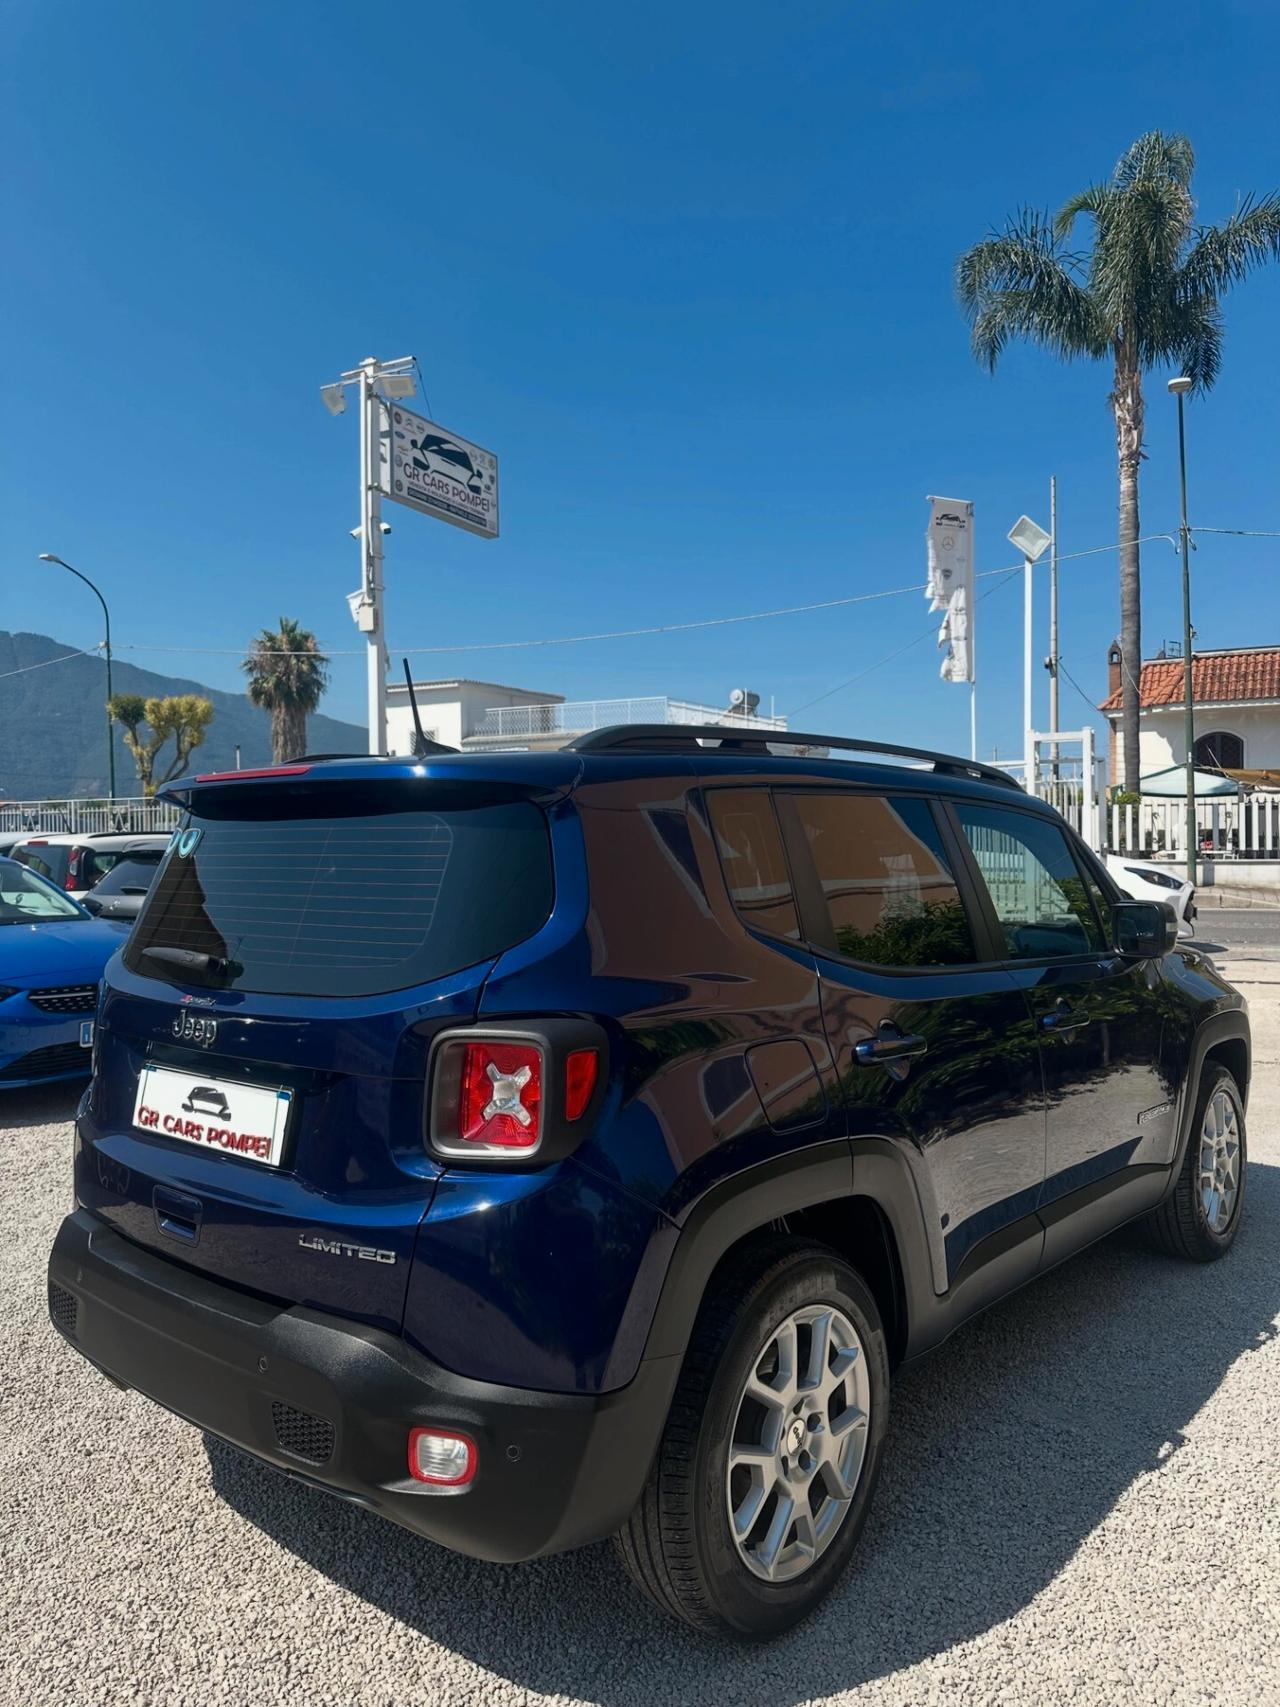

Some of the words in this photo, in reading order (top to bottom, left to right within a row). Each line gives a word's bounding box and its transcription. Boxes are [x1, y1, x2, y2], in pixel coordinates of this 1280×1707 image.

[403, 462, 420, 482] GR
[422, 472, 450, 495] CARS
[452, 486, 490, 513] POMPEI
[172, 1009, 217, 1048] Jeep
[137, 1106, 160, 1129] GR
[163, 1114, 204, 1141] CARS
[206, 1126, 272, 1160] POMPEI
[298, 1233, 396, 1265] LIMITED
